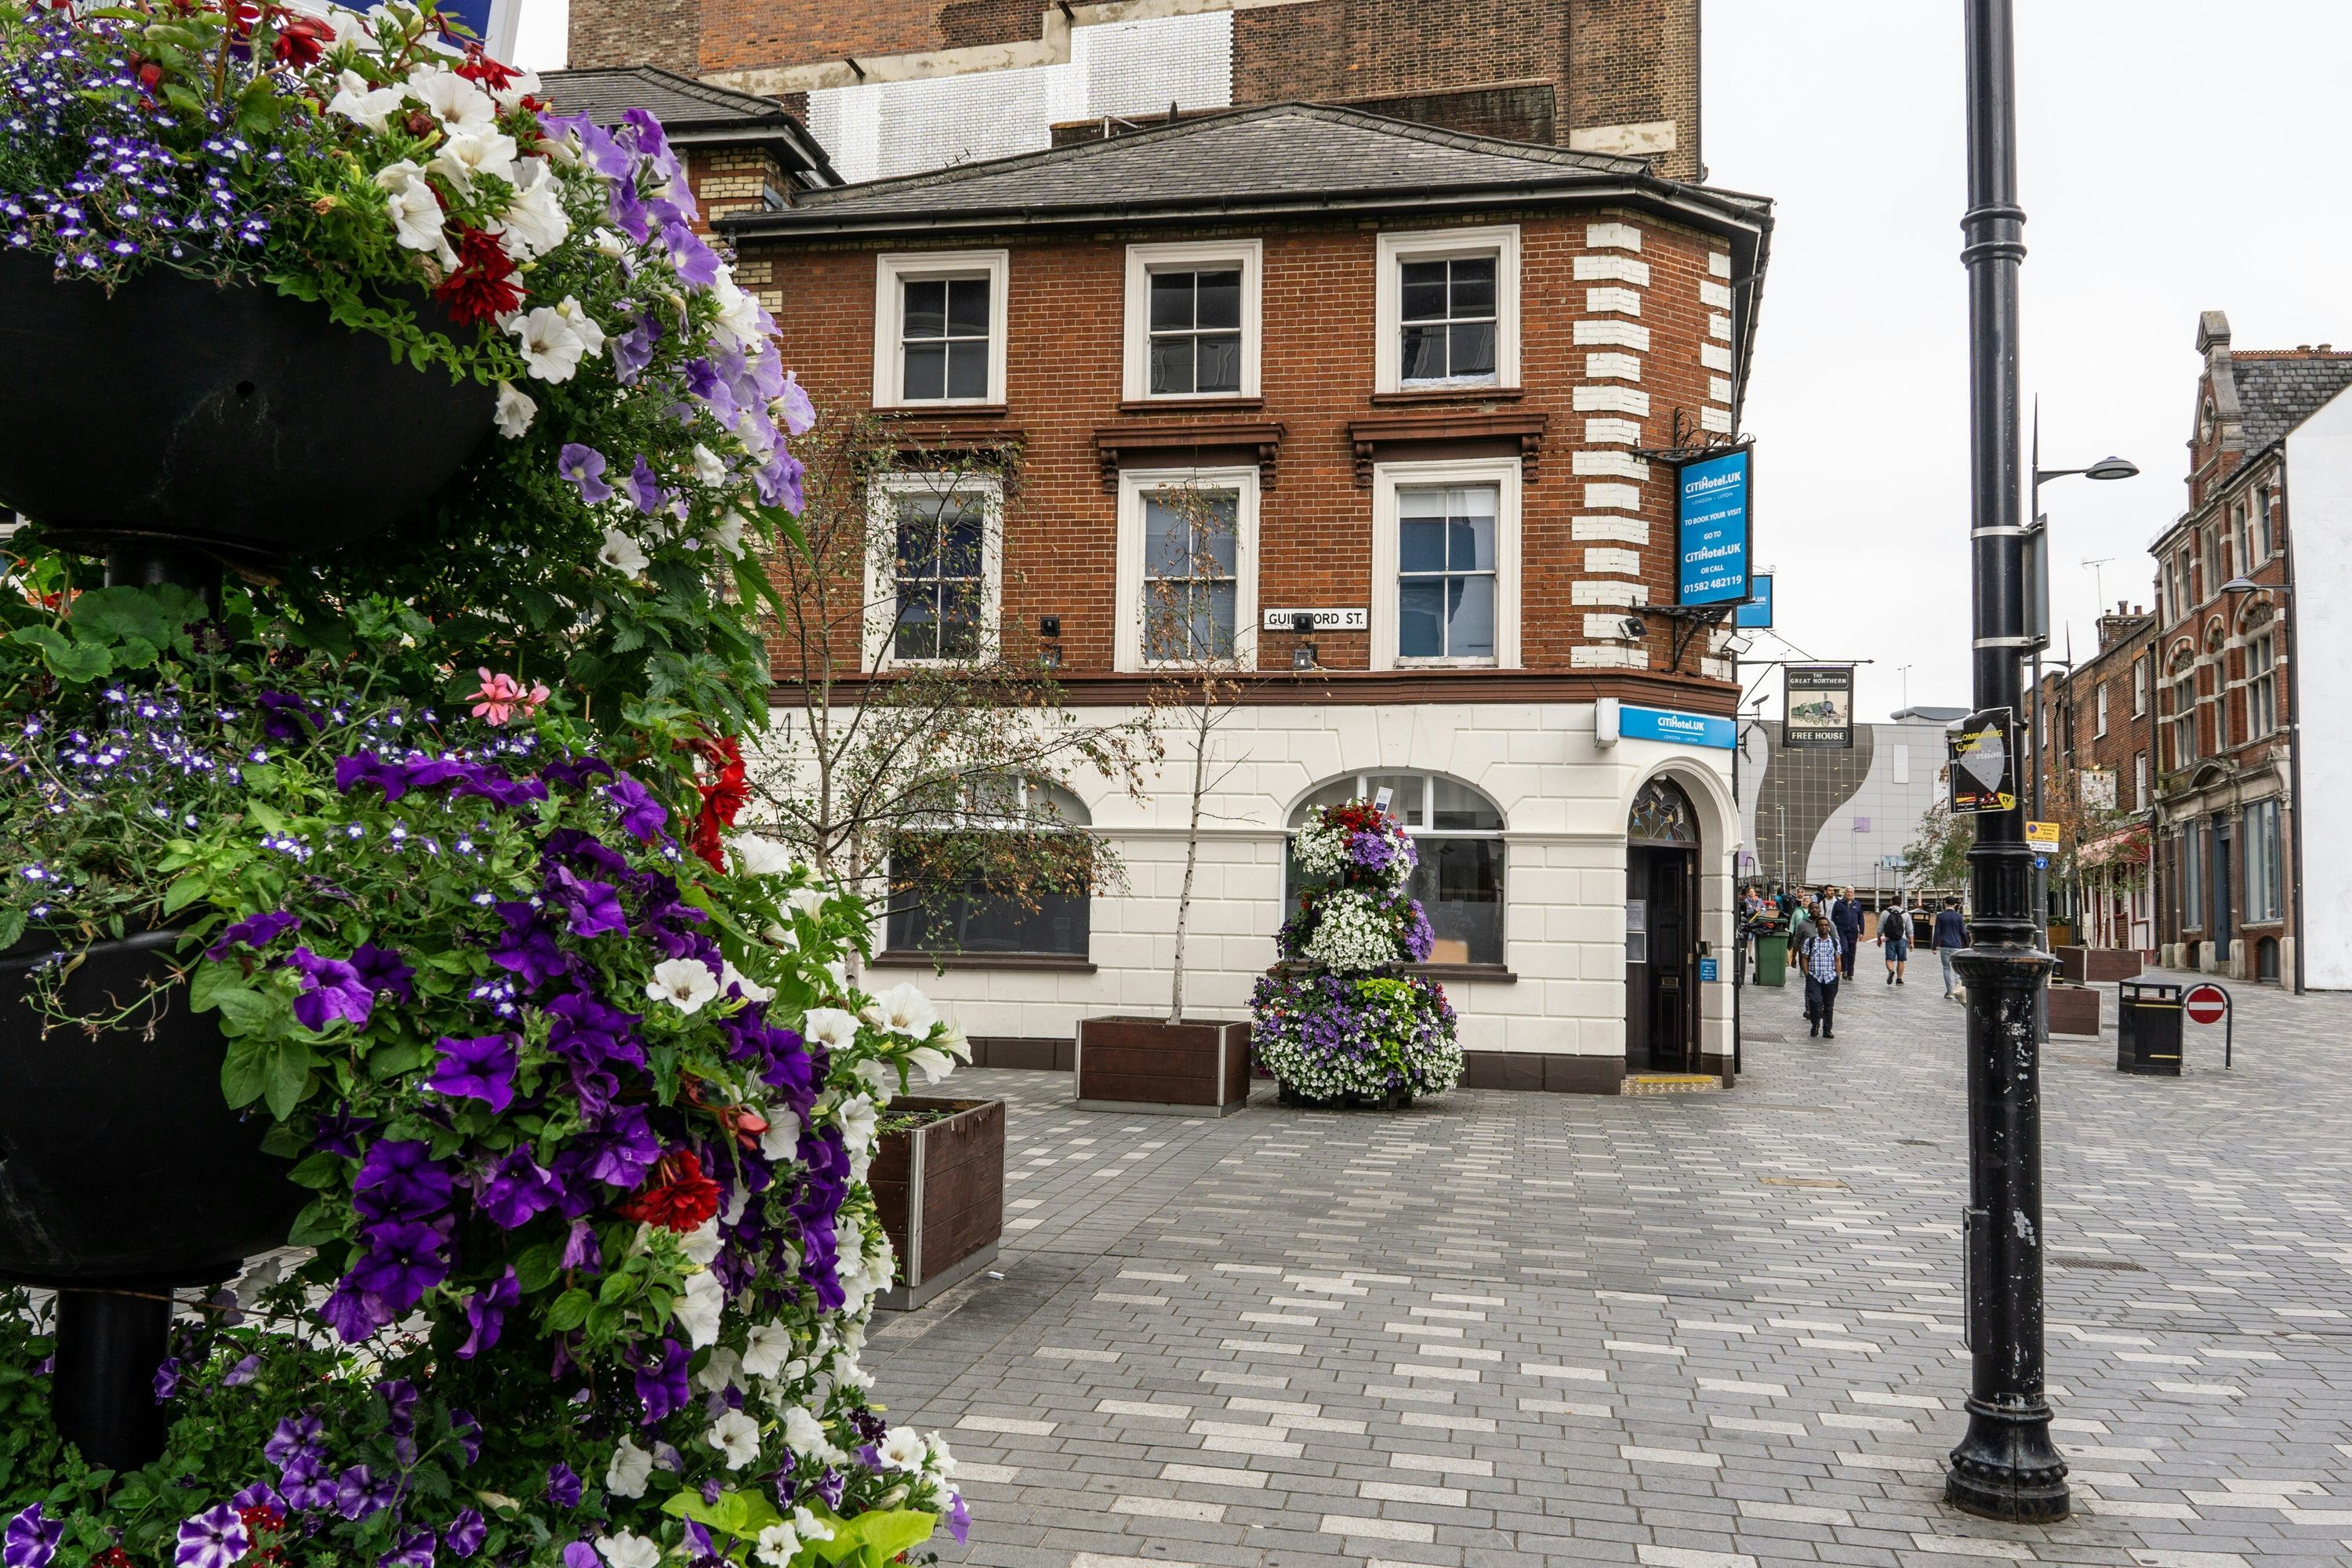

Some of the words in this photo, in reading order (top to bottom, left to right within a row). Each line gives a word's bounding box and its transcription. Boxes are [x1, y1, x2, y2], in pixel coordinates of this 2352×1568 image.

[1692, 497, 1712, 506] LONDON
[1693, 514, 1709, 524] BOOK
[1709, 511, 1726, 521] YOUR
[1727, 507, 1742, 517] VISIT
[1713, 530, 1722, 539] TO
[1684, 582, 1709, 593] 01582
[1711, 575, 1742, 588] 482119
[1269, 613, 1339, 624] GUILORD
[1346, 613, 1363, 624] ST.
[1962, 729, 2003, 741] OMBATING
